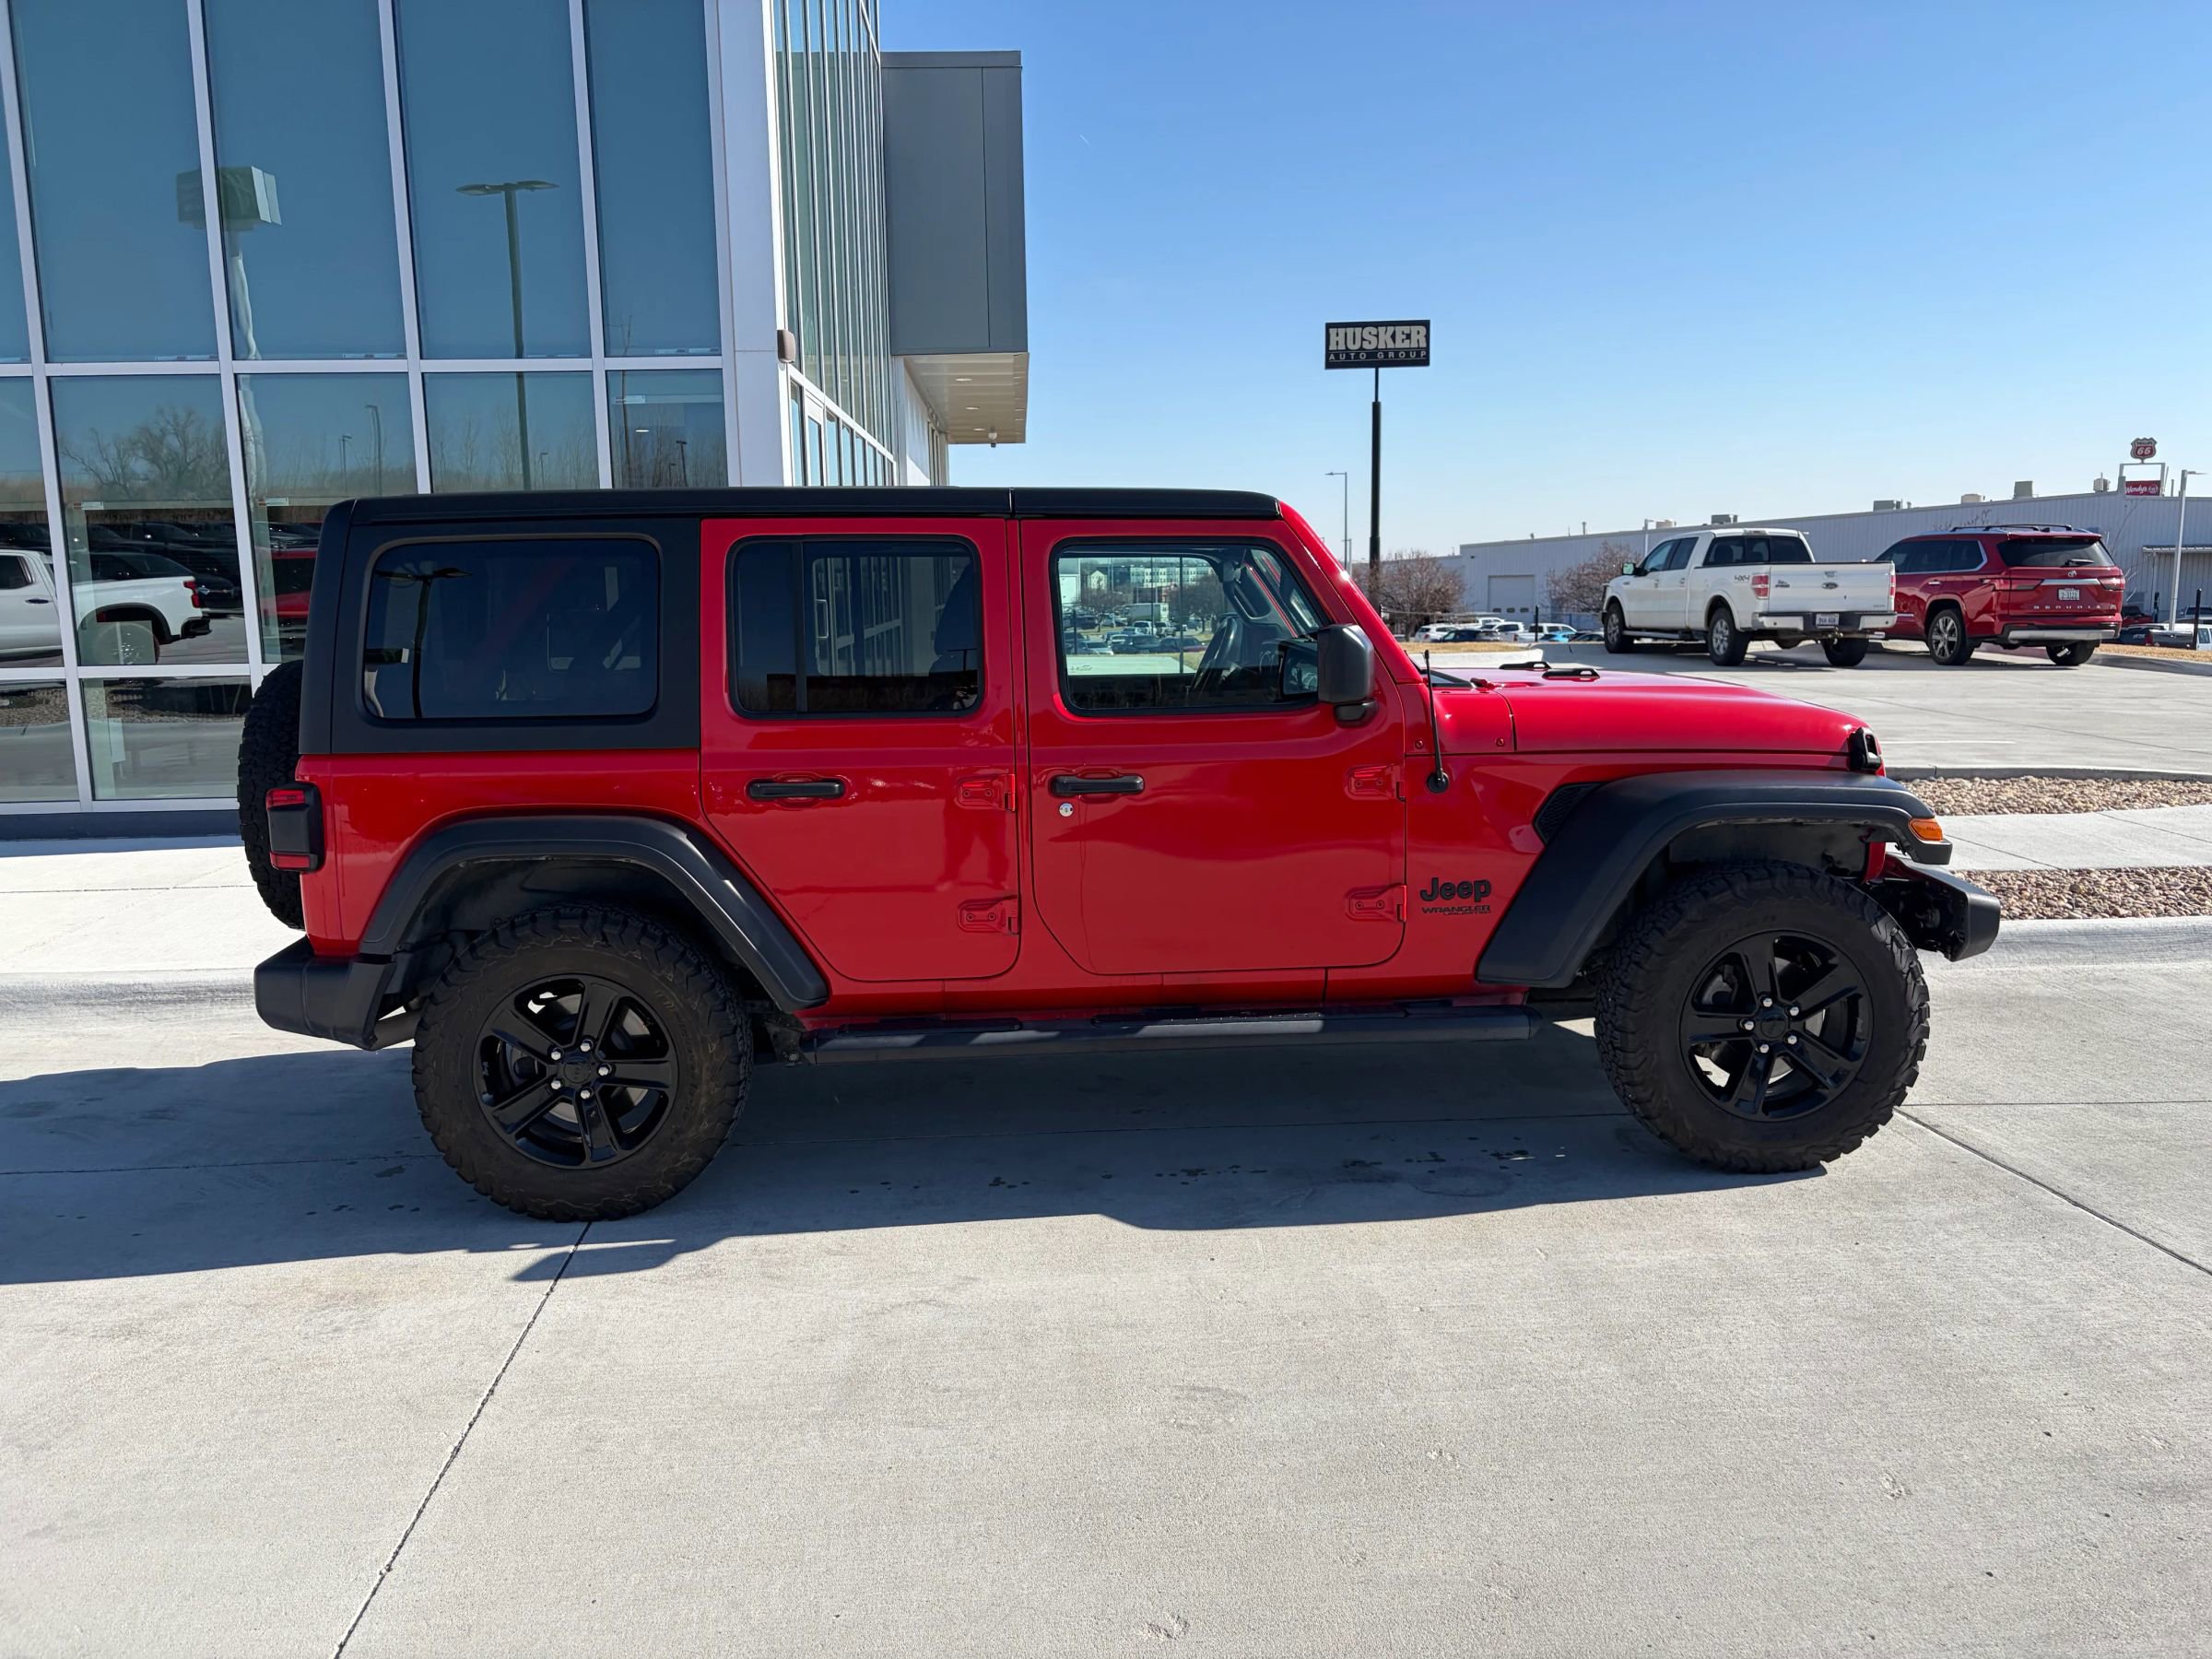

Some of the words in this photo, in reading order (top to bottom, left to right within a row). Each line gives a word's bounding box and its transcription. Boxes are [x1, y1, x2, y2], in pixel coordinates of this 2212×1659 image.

[1328, 325, 1427, 350] HUSKER
[1377, 350, 1427, 359] GROUP
[2136, 447, 2151, 455] 66
[1420, 877, 1491, 902] Jeep
[1422, 905, 1490, 913] WRANGLER
